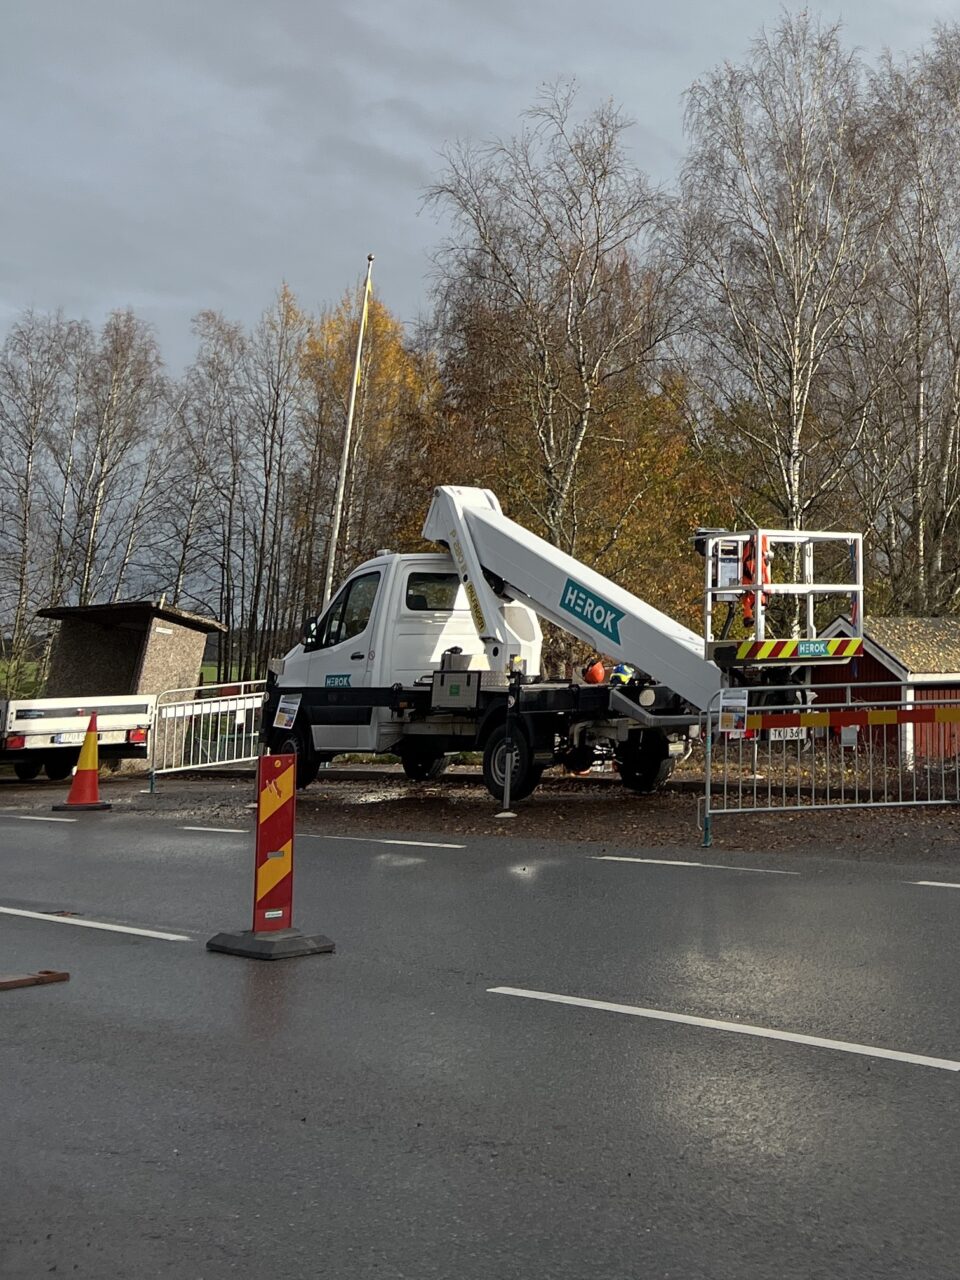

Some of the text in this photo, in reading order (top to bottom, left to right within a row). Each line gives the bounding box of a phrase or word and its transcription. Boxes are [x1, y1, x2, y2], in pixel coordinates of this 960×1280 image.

[564, 586, 616, 633] HEROK
[800, 643, 826, 653] HEROK
[326, 677, 348, 686] HEROK
